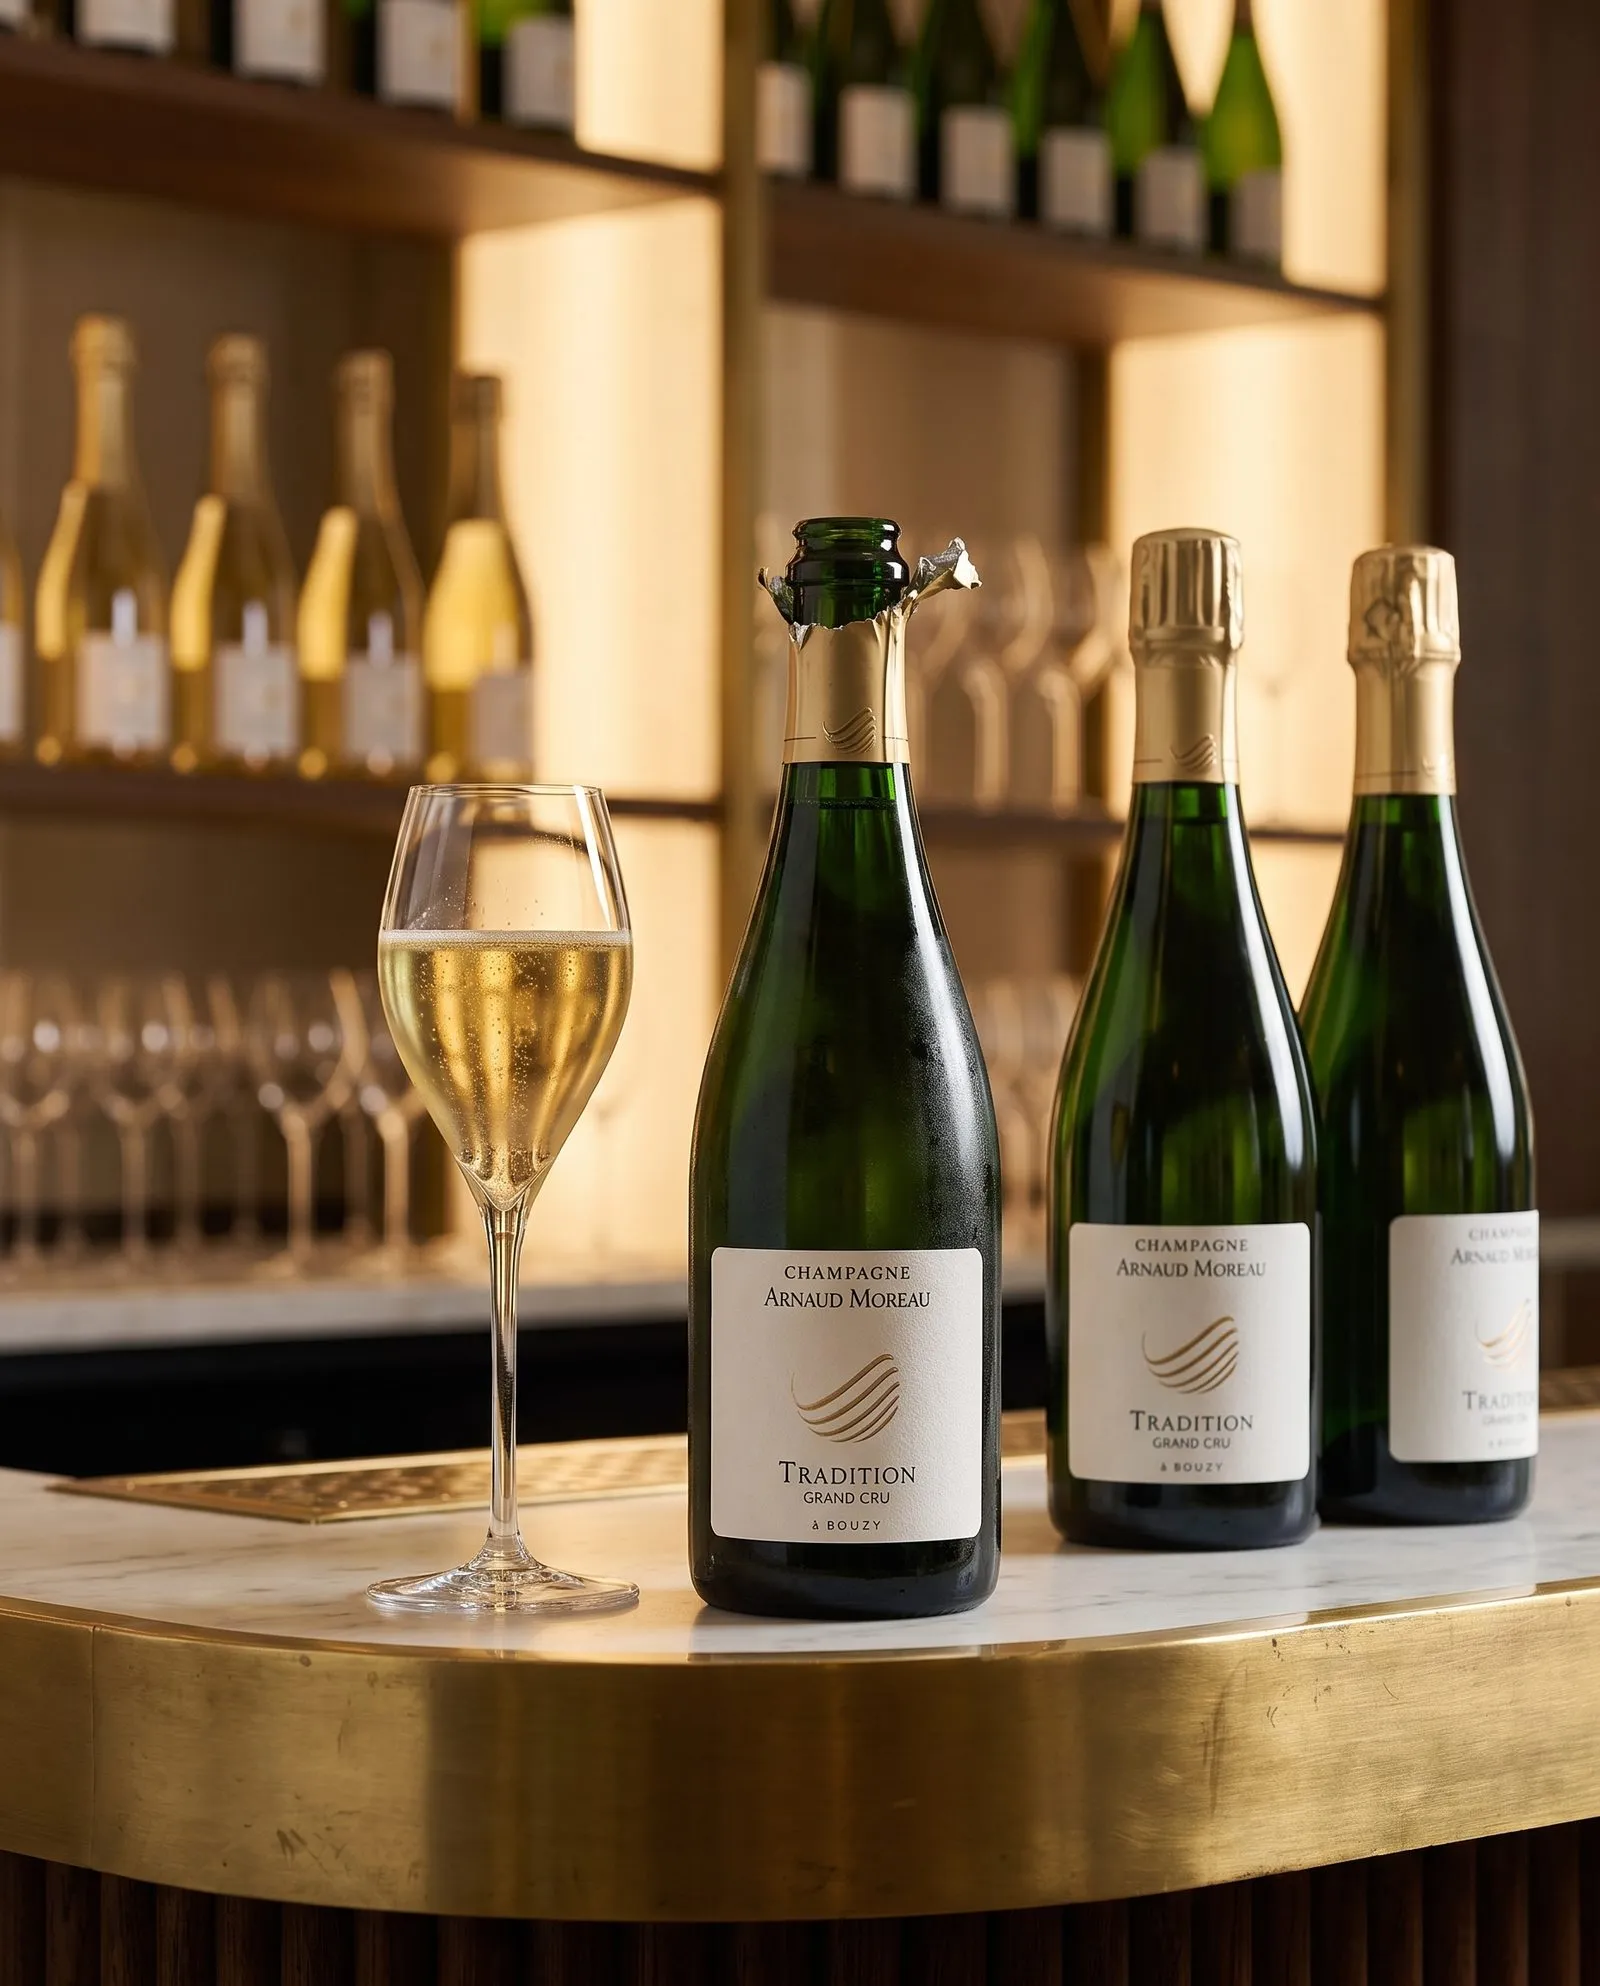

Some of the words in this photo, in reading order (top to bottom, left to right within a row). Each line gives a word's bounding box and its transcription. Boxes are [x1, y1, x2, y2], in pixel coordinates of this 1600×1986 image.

[1135, 1239, 1249, 1252] CHAMPAGNE
[785, 1266, 910, 1280] CHAMPAGNE
[1117, 1258, 1188, 1277] ARNAUD
[1194, 1260, 1266, 1277] MOREAU
[764, 1287, 843, 1308] ARNAUD
[849, 1289, 931, 1308] MOREAU
[1130, 1410, 1254, 1432] TRADITION
[1153, 1437, 1199, 1449] GRAND
[1203, 1437, 1231, 1449] CRU
[779, 1461, 916, 1484] TRADITION
[1174, 1463, 1223, 1472] BOUZY
[803, 1491, 855, 1504] GRAND
[859, 1491, 890, 1504] CRU
[827, 1521, 881, 1531] BOUZY
